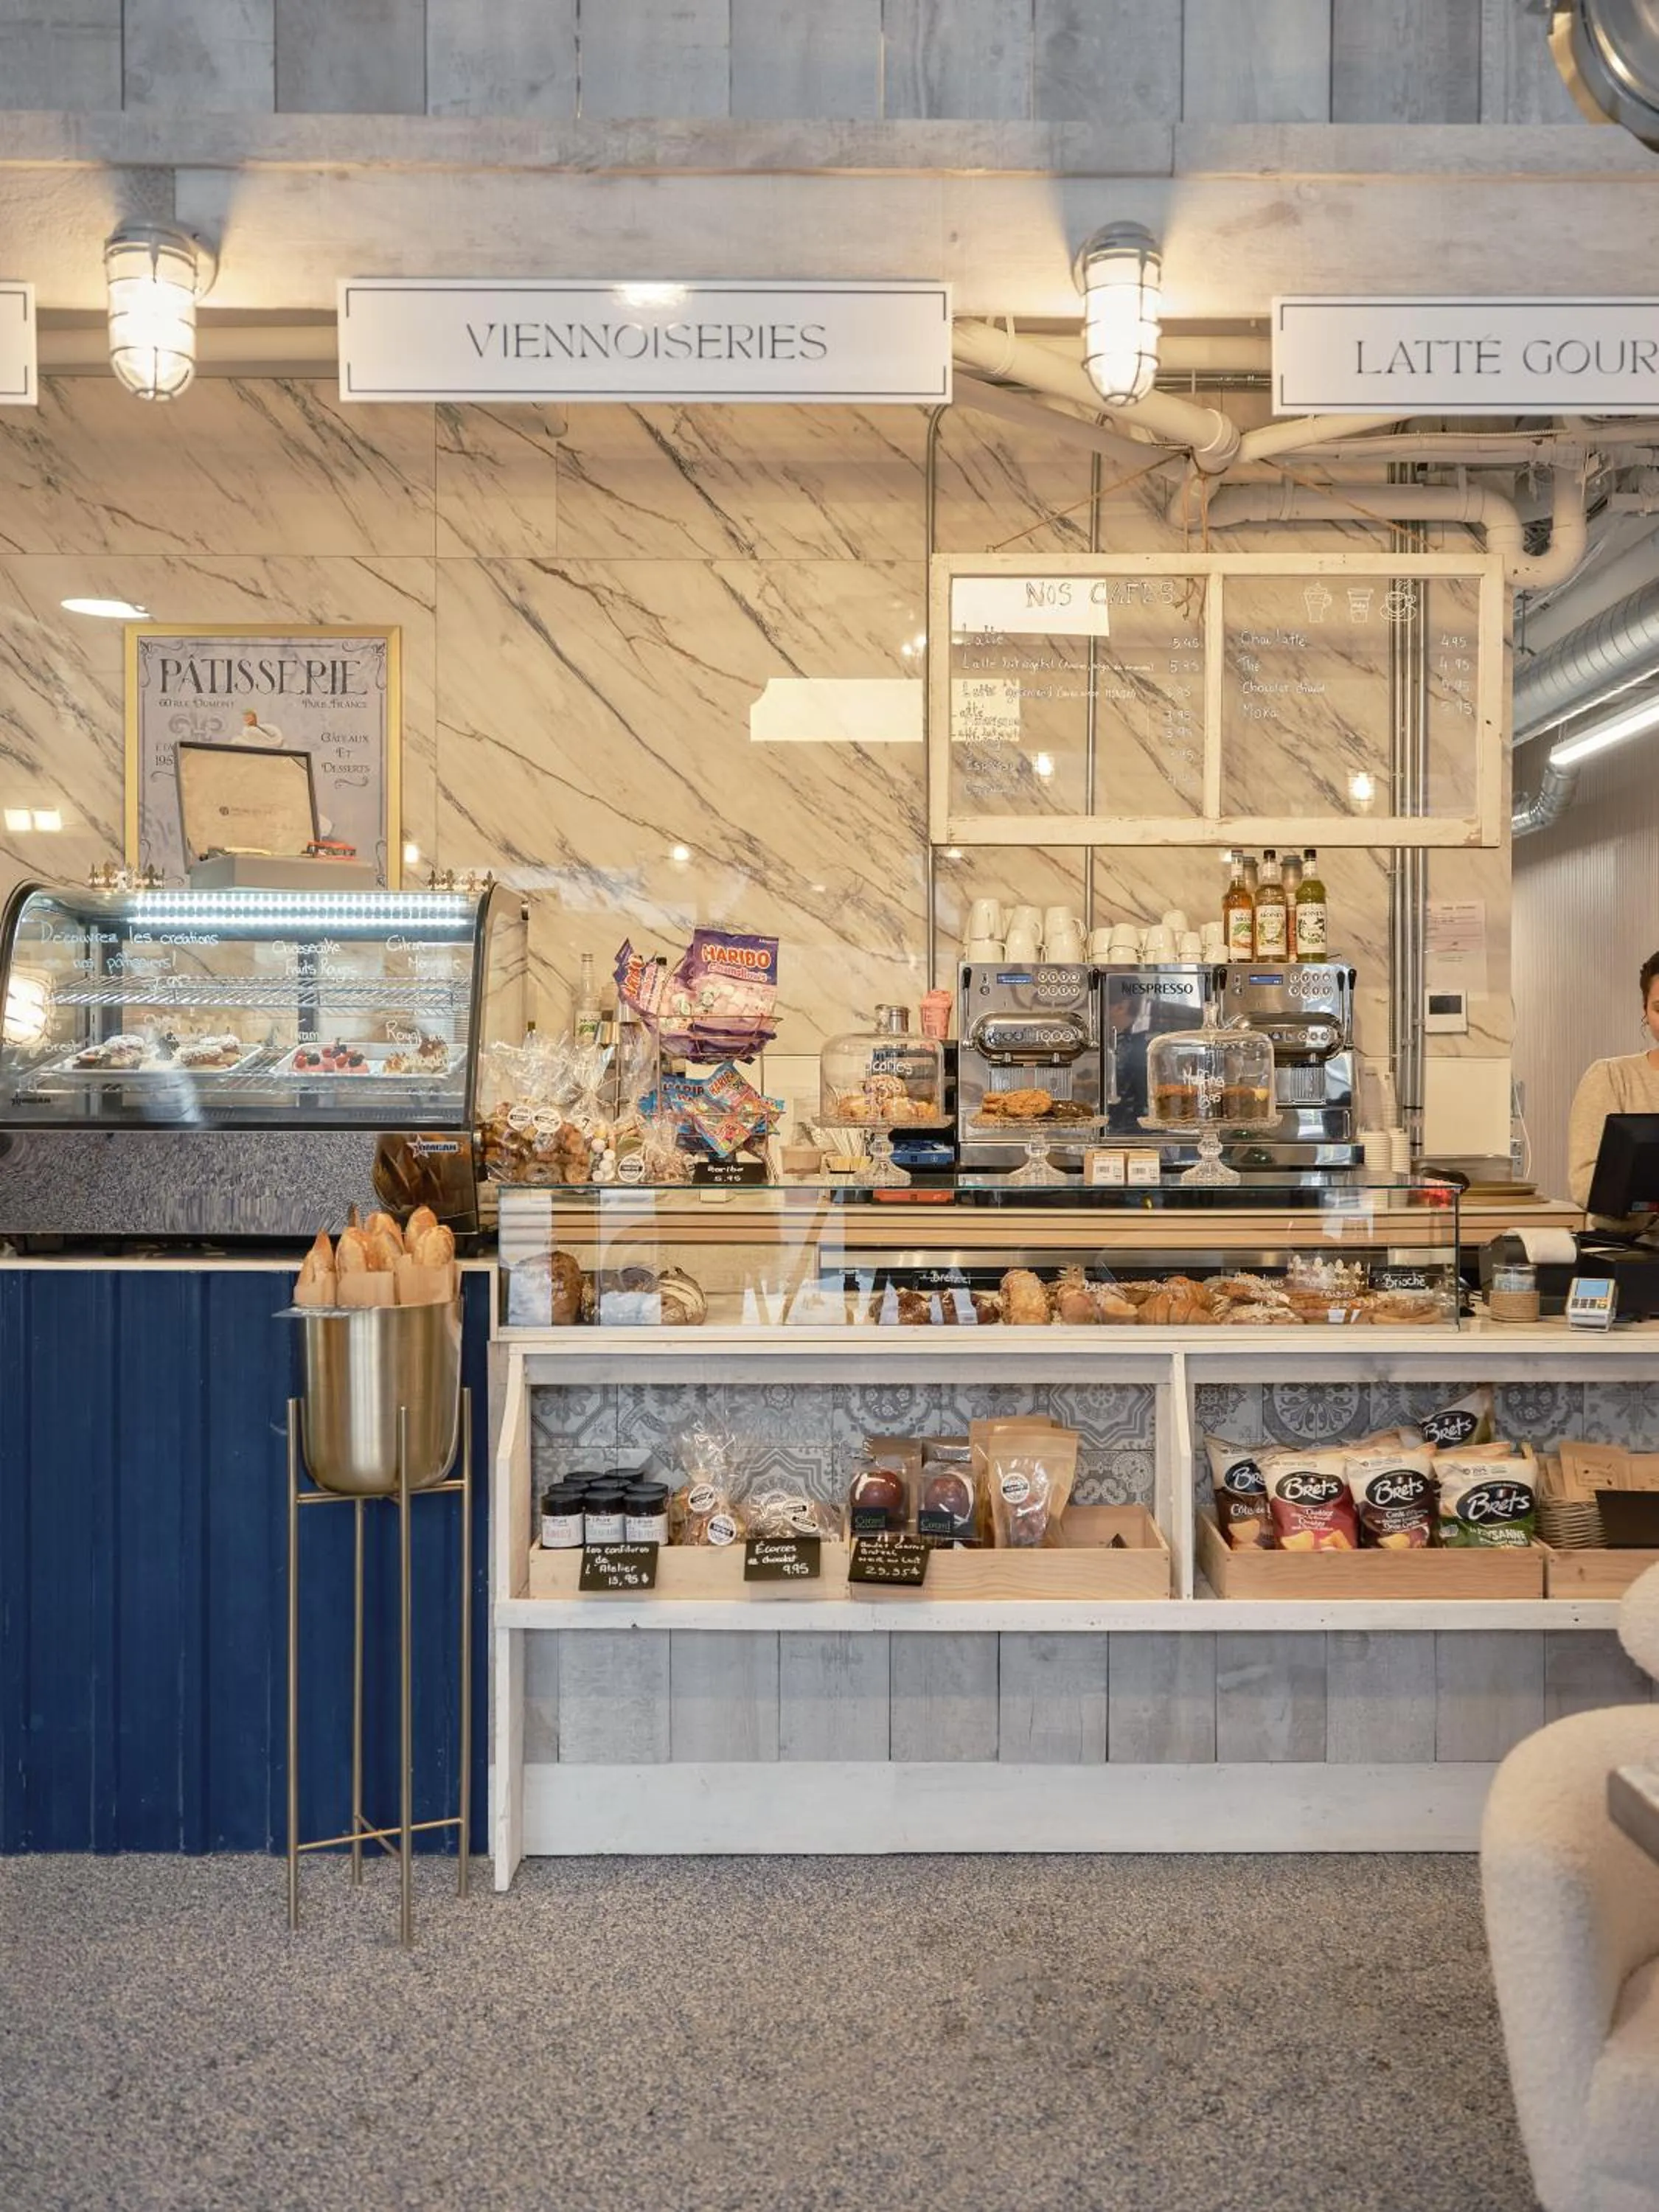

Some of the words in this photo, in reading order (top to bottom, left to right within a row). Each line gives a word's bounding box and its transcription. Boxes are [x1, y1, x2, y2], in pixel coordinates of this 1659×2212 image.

[466, 322, 828, 361] VIENNOISERIES
[1355, 335, 1502, 374] LATTÉ
[1025, 580, 1072, 608] NOS
[159, 654, 368, 695] PÂTISSERIE
[129, 925, 153, 945] les
[701, 943, 771, 970] HARIBO
[1121, 981, 1194, 995] NESPRESSO
[1424, 1414, 1473, 1444] Brets
[1282, 1476, 1339, 1500] Brets
[1373, 1475, 1425, 1506] Brets
[1467, 1489, 1530, 1521] Brets
